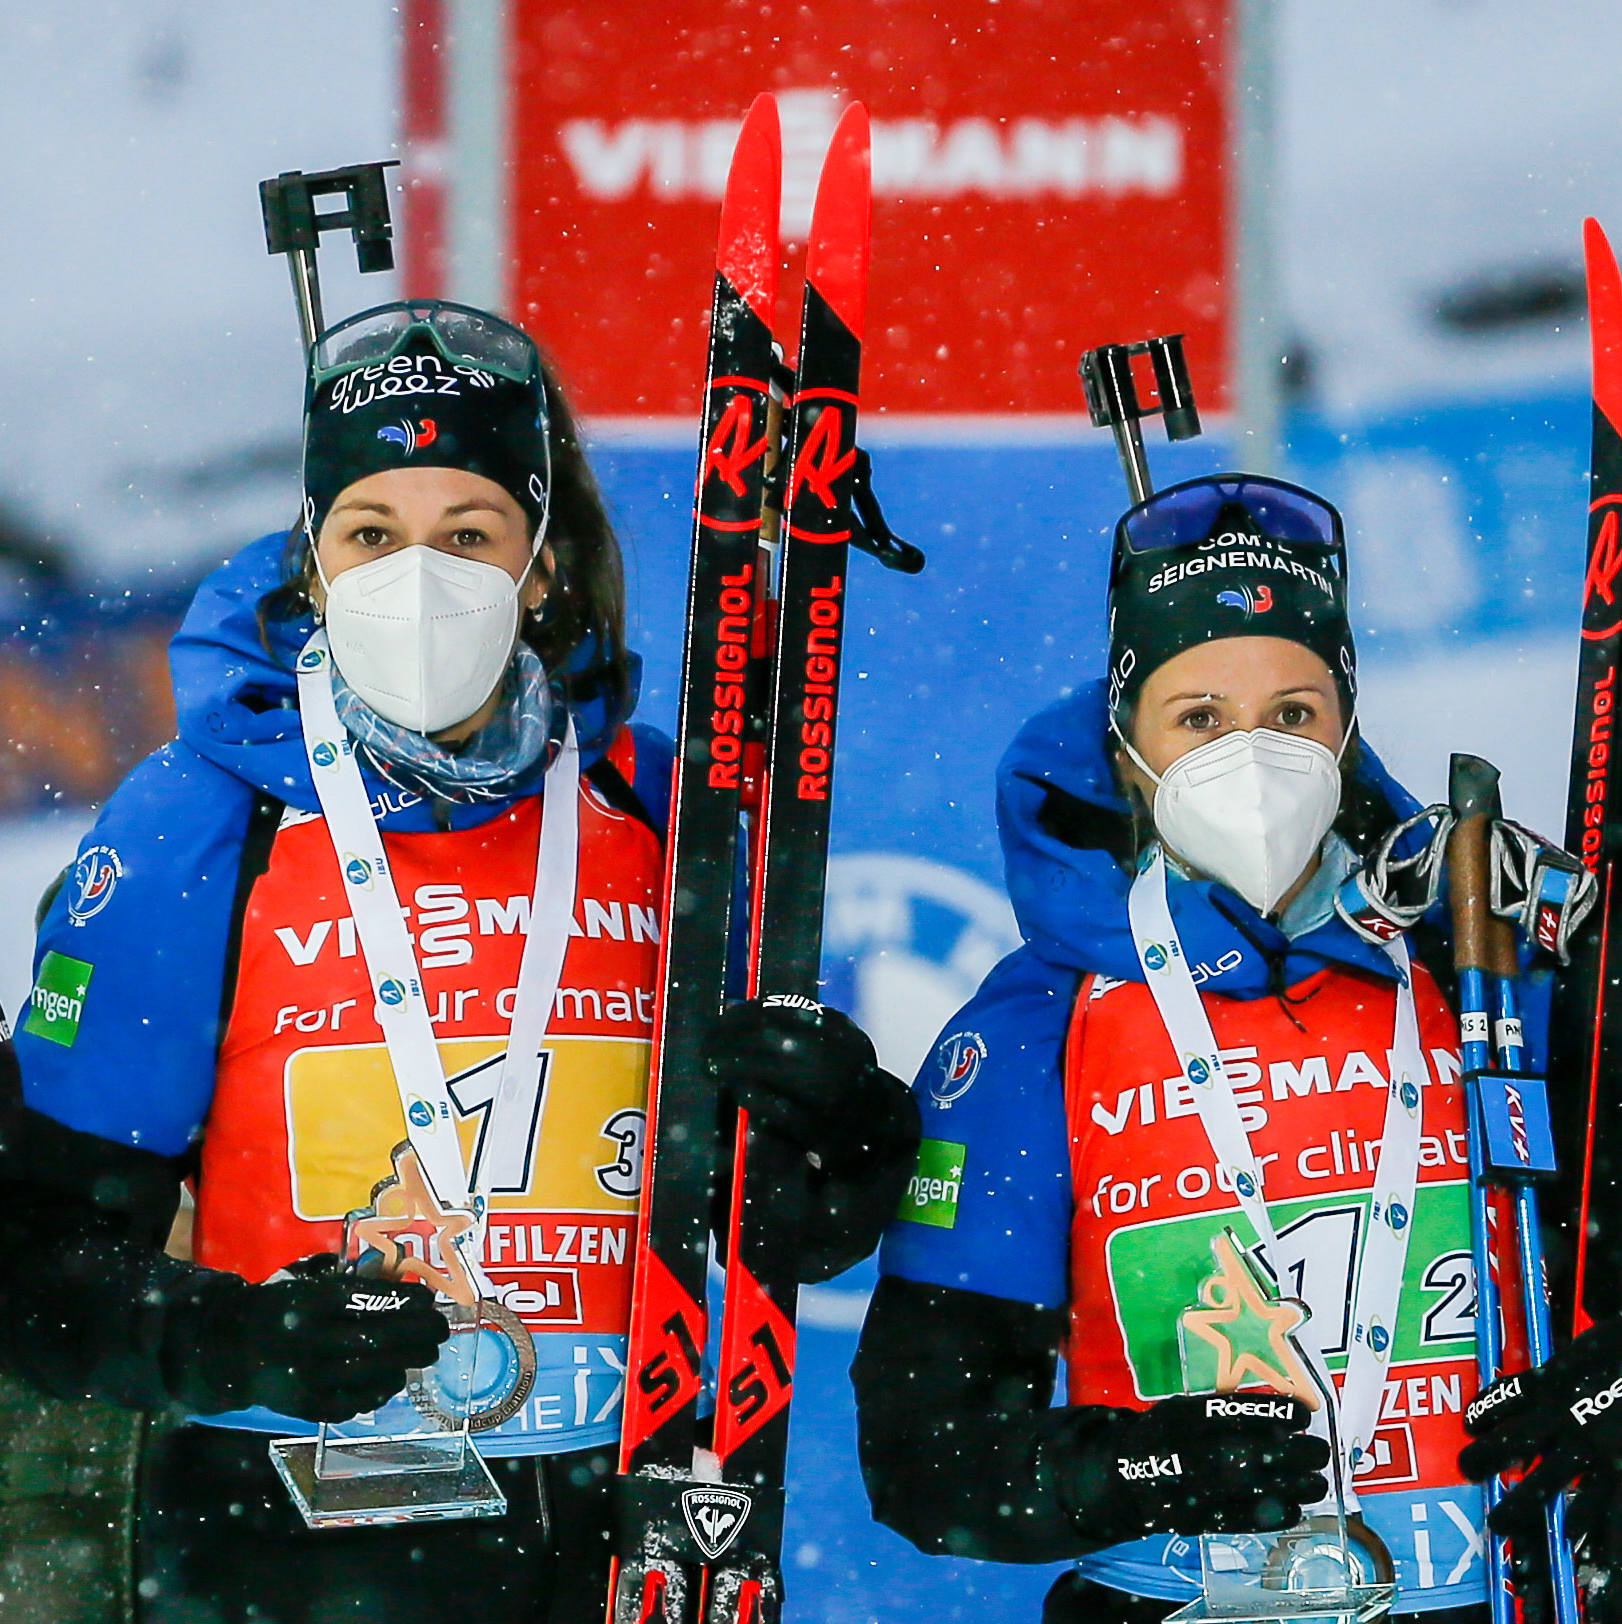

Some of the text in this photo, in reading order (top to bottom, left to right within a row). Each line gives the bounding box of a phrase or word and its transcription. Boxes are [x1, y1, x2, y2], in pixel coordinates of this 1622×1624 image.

[330, 355, 441, 411] green
[343, 375, 460, 414] weez
[707, 563, 753, 791] ROSSIGNOL
[797, 576, 842, 800] ROSSIGNOL
[1582, 666, 1616, 874] ROSSIGNOL
[30, 986, 82, 1022] mgen
[1190, 948, 1243, 985] dlo
[275, 1001, 357, 1035] for
[448, 1049, 552, 1197] 1
[597, 1109, 646, 1197] 3
[1092, 1173, 1162, 1219] for
[1251, 1205, 1367, 1357] 1
[1420, 1252, 1479, 1343] 2
[730, 1314, 793, 1428] S1
[691, 1495, 741, 1510] ROSSIGNOL
